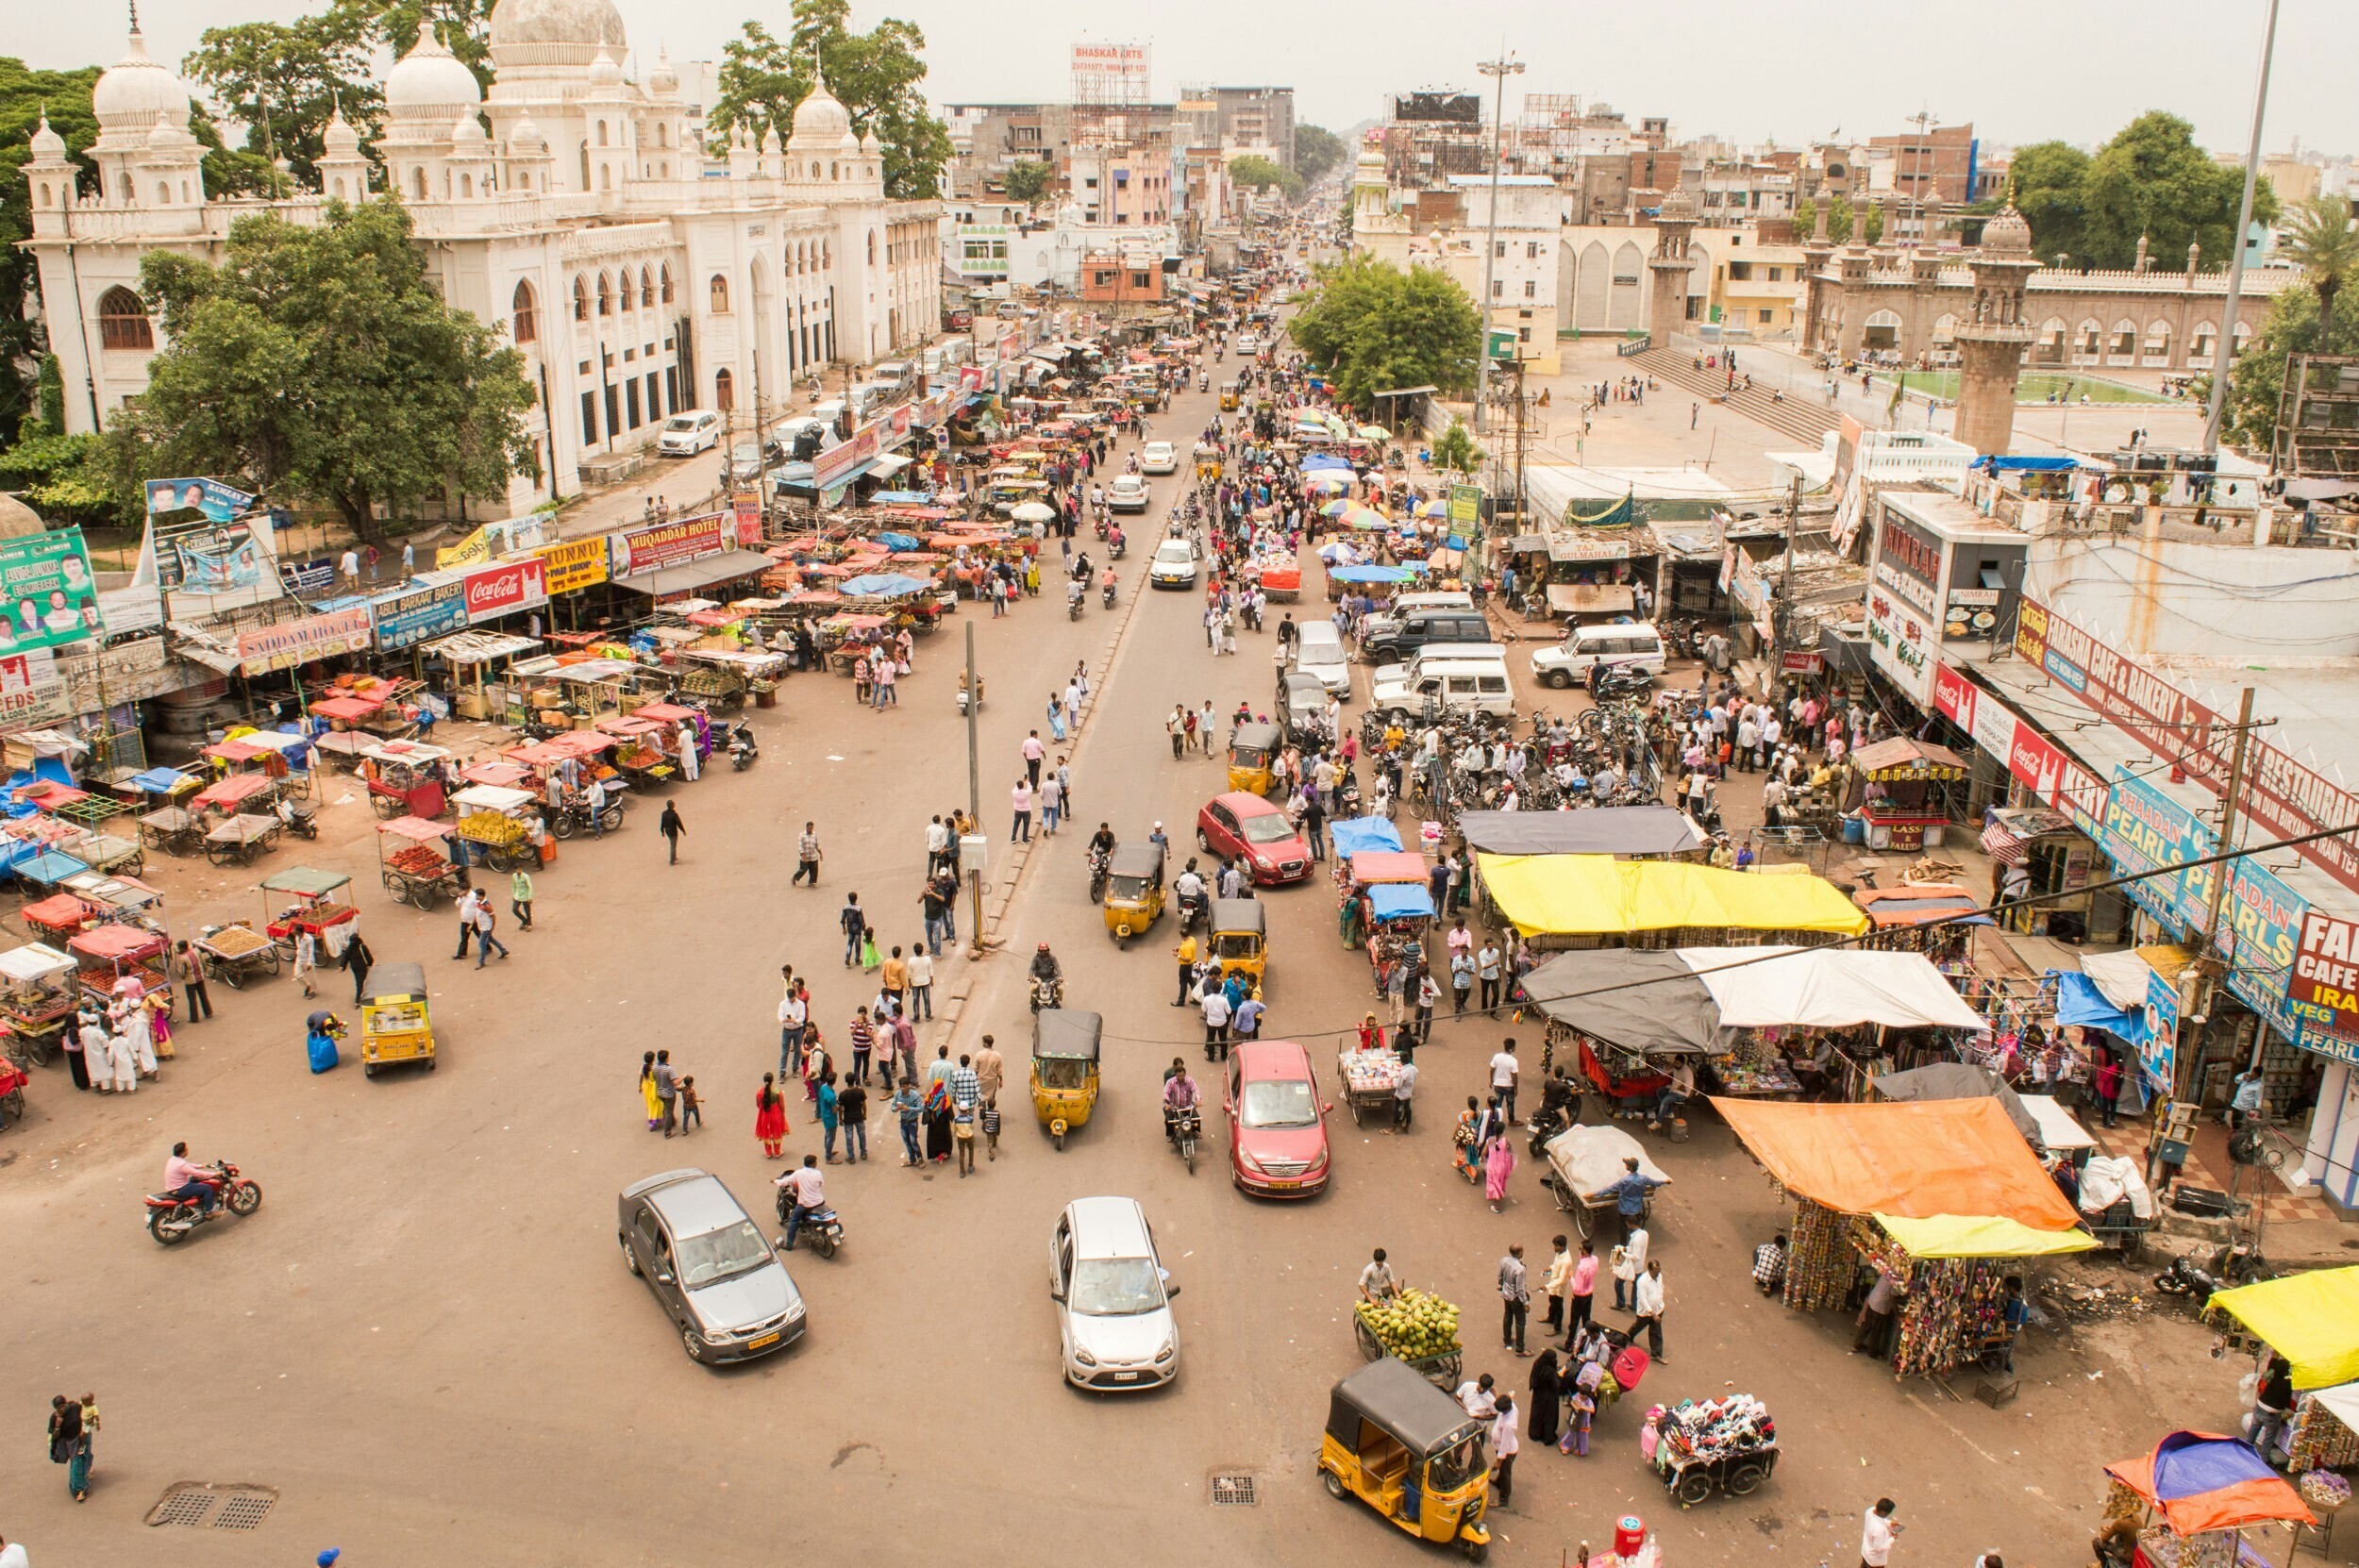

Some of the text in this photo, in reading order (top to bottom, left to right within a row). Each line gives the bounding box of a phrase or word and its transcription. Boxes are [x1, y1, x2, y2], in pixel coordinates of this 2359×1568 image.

[1076, 47, 1117, 58] BHASKAR
[630, 528, 687, 548] MUQADDAR
[689, 519, 719, 537] HOTEL
[541, 541, 598, 567] MUNNU
[1885, 521, 1941, 582] NIMRAH
[6, 559, 60, 583] ALVIDA JUMMA
[550, 560, 592, 577] PAN SHOP
[13, 577, 60, 596] EID MUBARAK
[377, 600, 398, 619] ABUL
[400, 590, 434, 612] BARKAAT
[434, 580, 463, 602] BAKERY
[471, 574, 519, 604] Coca-Cola
[246, 629, 309, 652] SADDAM
[312, 618, 364, 641] HOTEL
[2046, 613, 2180, 725] FARASHA CAFE & BAKERY
[2048, 653, 2085, 689] VEG NON-VEG
[35, 684, 63, 696] GENERAL
[41, 692, 60, 701] STORE
[1936, 679, 1958, 709] Coca-Cola
[8, 709, 27, 719] COOL
[29, 702, 50, 713] POINT
[1997, 735, 2008, 750] CAFE
[2014, 742, 2041, 776] Coca-Cola
[2062, 761, 2109, 823] KERY
[2107, 693, 2132, 725] CHINESE
[2158, 729, 2165, 745] &
[2262, 795, 2281, 823] DUM
[2317, 837, 2342, 865] IRANI
[2342, 849, 2359, 877] TEA
[2259, 746, 2359, 849] RESTAURAN
[1893, 825, 1924, 833] LASSI
[2076, 810, 2092, 832] NON
[2092, 822, 2103, 841] VE
[2117, 787, 2183, 847] SHAADAN
[2107, 802, 2184, 877] PEARLS
[2297, 955, 2358, 991] CAFE
[2292, 1000, 2332, 1024] VEG
[2299, 1029, 2359, 1062] PEARL
